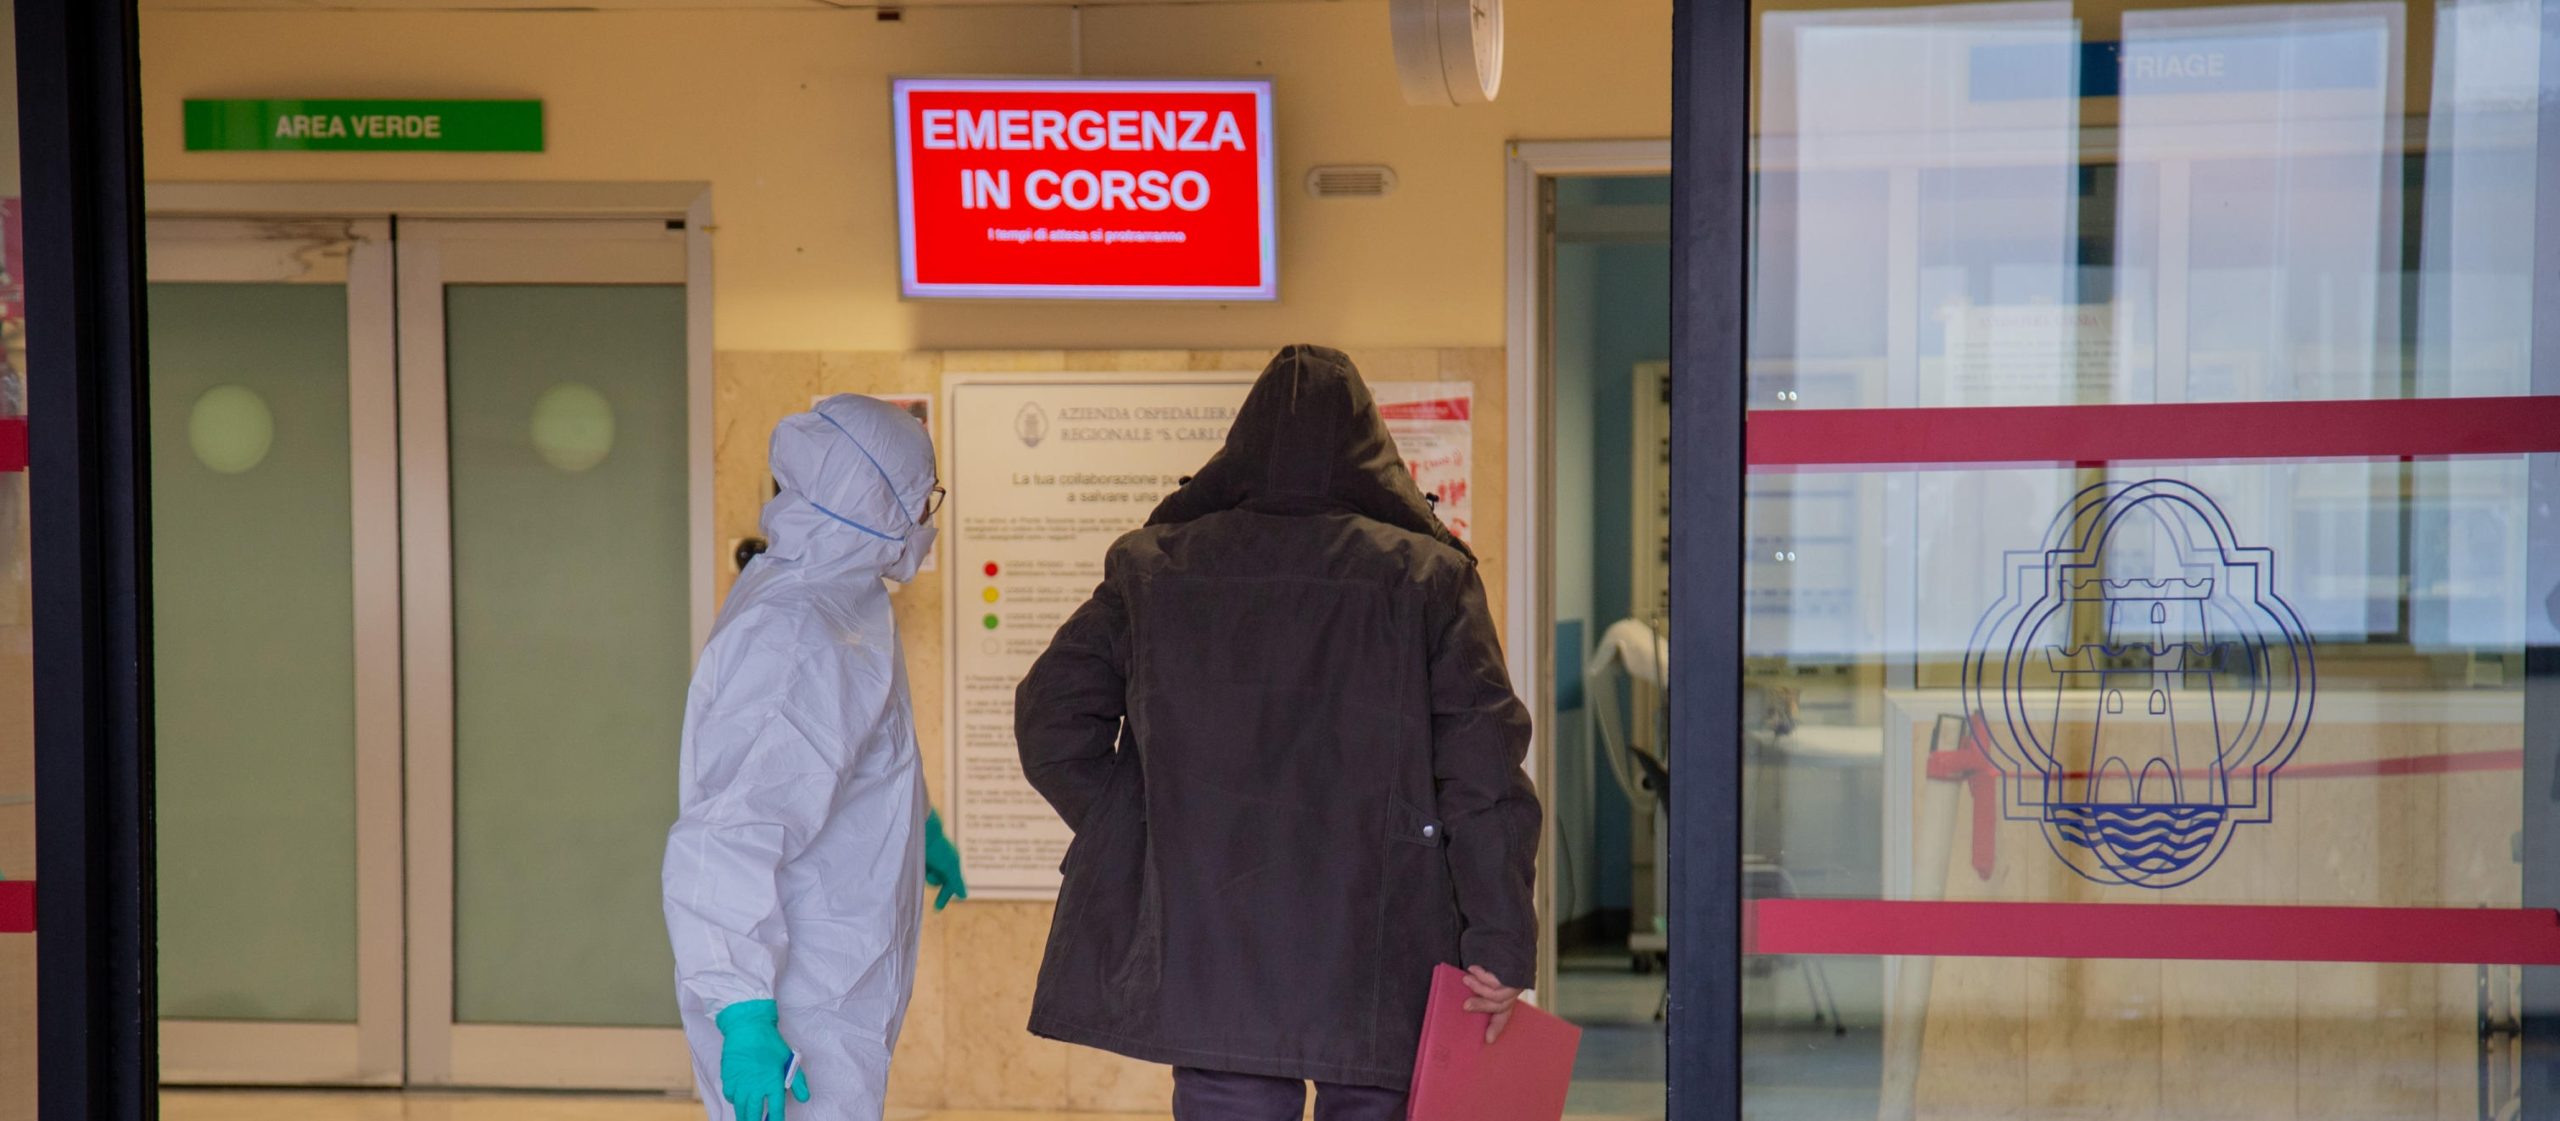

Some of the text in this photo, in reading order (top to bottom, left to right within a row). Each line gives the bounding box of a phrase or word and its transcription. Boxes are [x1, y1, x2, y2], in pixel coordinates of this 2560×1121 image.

[2117, 53, 2225, 80] TRIAGE
[275, 115, 442, 138] AREA VERDE
[922, 109, 1246, 151] EMERGENZA
[960, 168, 1211, 211] IN CORSO
[995, 227, 1033, 244] tempi
[1034, 227, 1048, 241] di
[1049, 228, 1089, 242] attesa
[1090, 228, 1104, 242] si
[1105, 229, 1187, 245] protrarranno
[1057, 406, 1238, 420] AZIENDA OSPEDALIERA
[1060, 427, 1153, 441] REGIONALE
[1012, 472, 1030, 485] La
[1033, 473, 1055, 485] tua
[1058, 472, 1158, 486] collaborazione
[1066, 491, 1159, 503] a salvare una
